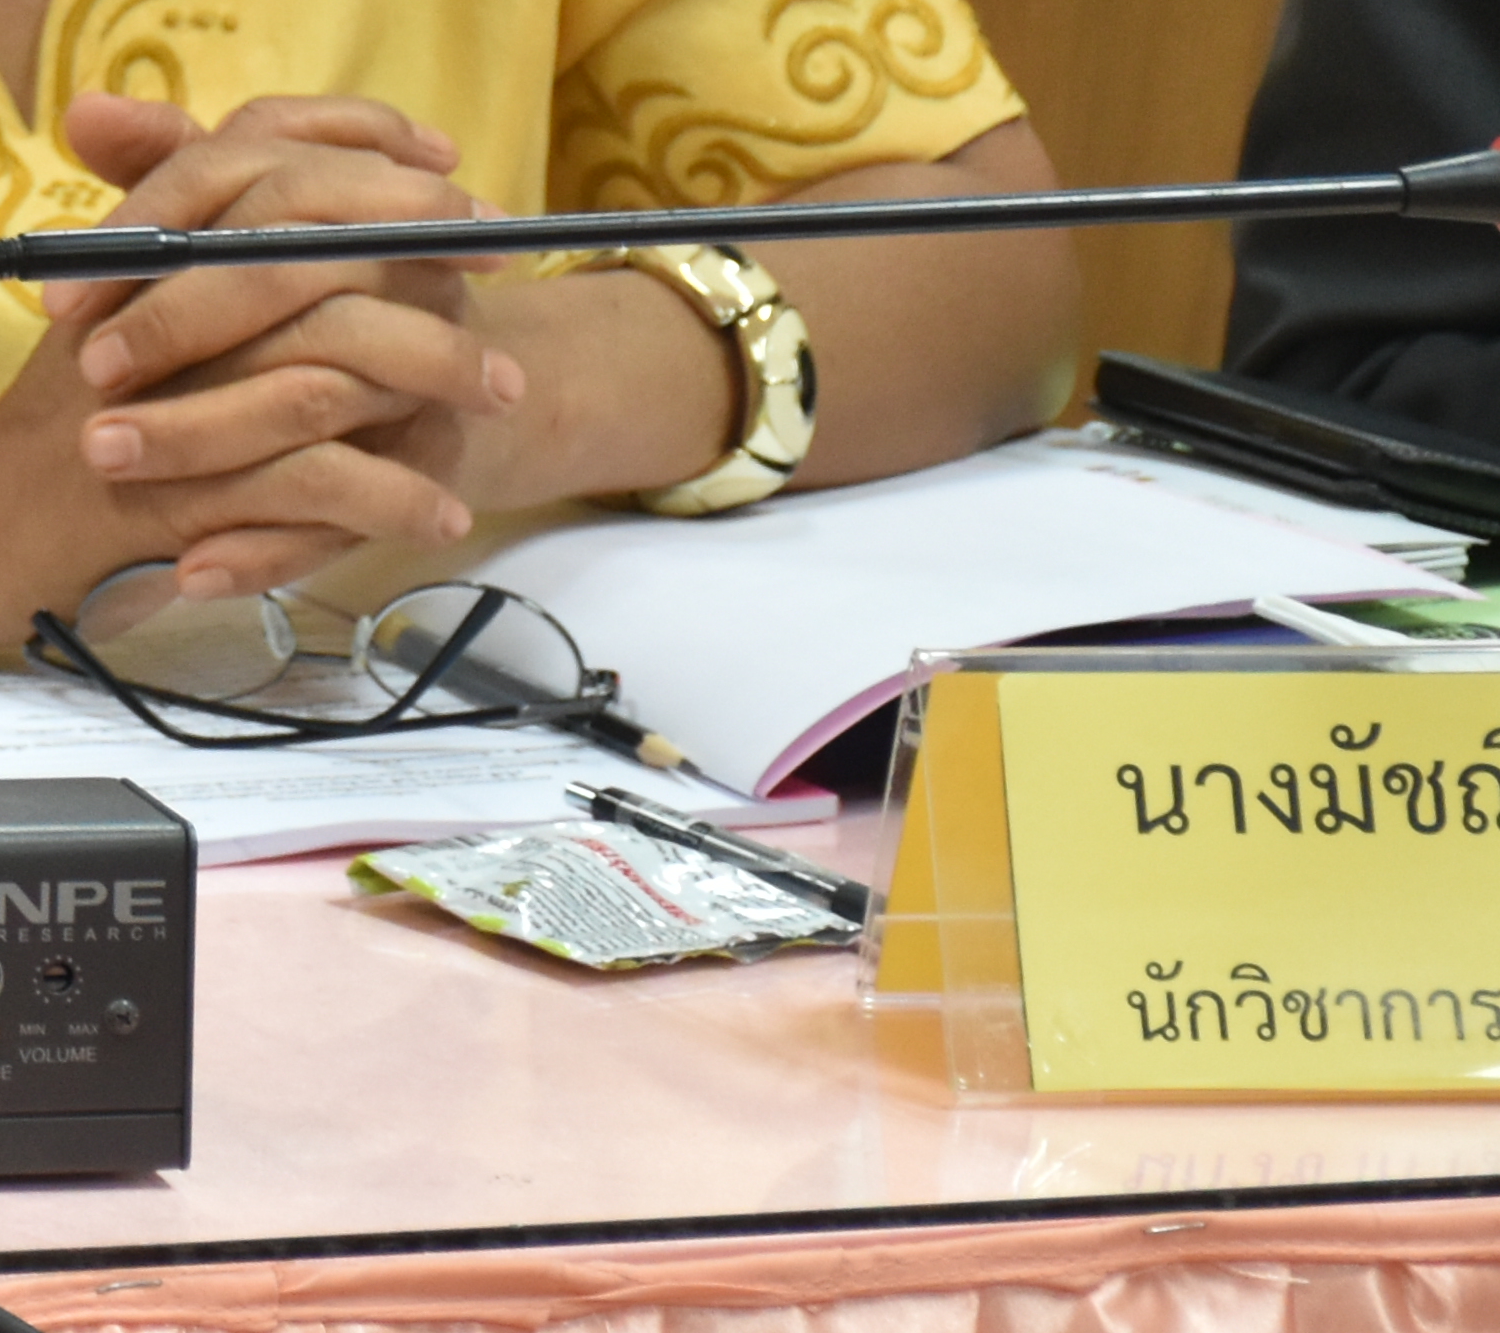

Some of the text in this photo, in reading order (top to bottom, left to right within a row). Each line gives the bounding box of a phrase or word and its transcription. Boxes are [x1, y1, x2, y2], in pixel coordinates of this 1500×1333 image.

[19, 1023, 99, 1036] MIN MAX
[19, 1046, 99, 1064] VOLUME
